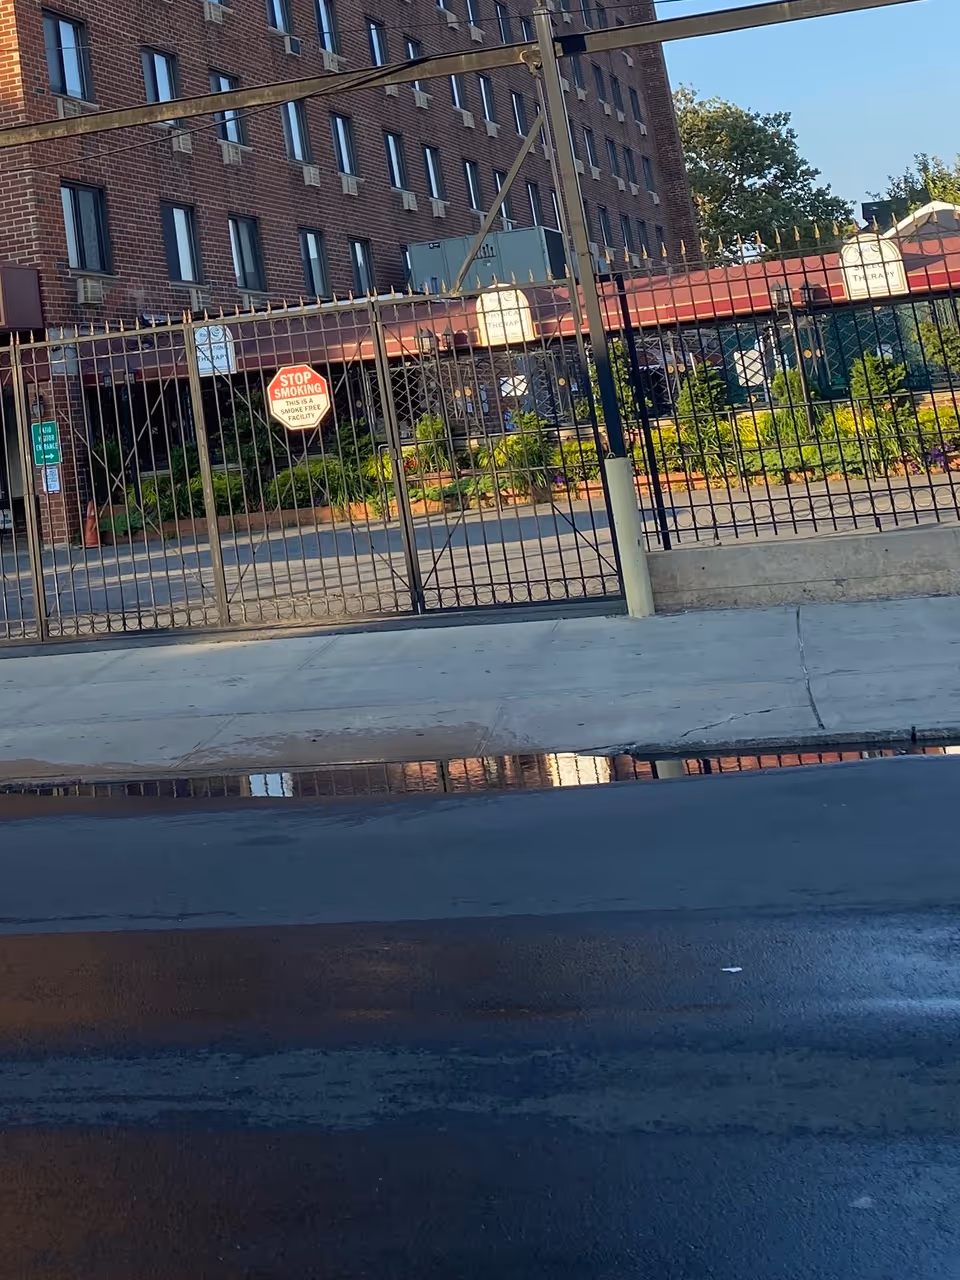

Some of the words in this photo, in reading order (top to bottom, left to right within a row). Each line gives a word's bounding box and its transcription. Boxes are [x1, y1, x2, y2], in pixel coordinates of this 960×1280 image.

[487, 320, 519, 329] THEAP
[280, 371, 311, 387] STOP
[274, 383, 322, 399] SMOKING
[280, 406, 303, 415] SMOKE
[304, 404, 321, 412] FREE
[288, 413, 316, 421] FACILITY
[37, 434, 55, 443] VSITOR
[36, 442, 58, 451] ENRANCE
